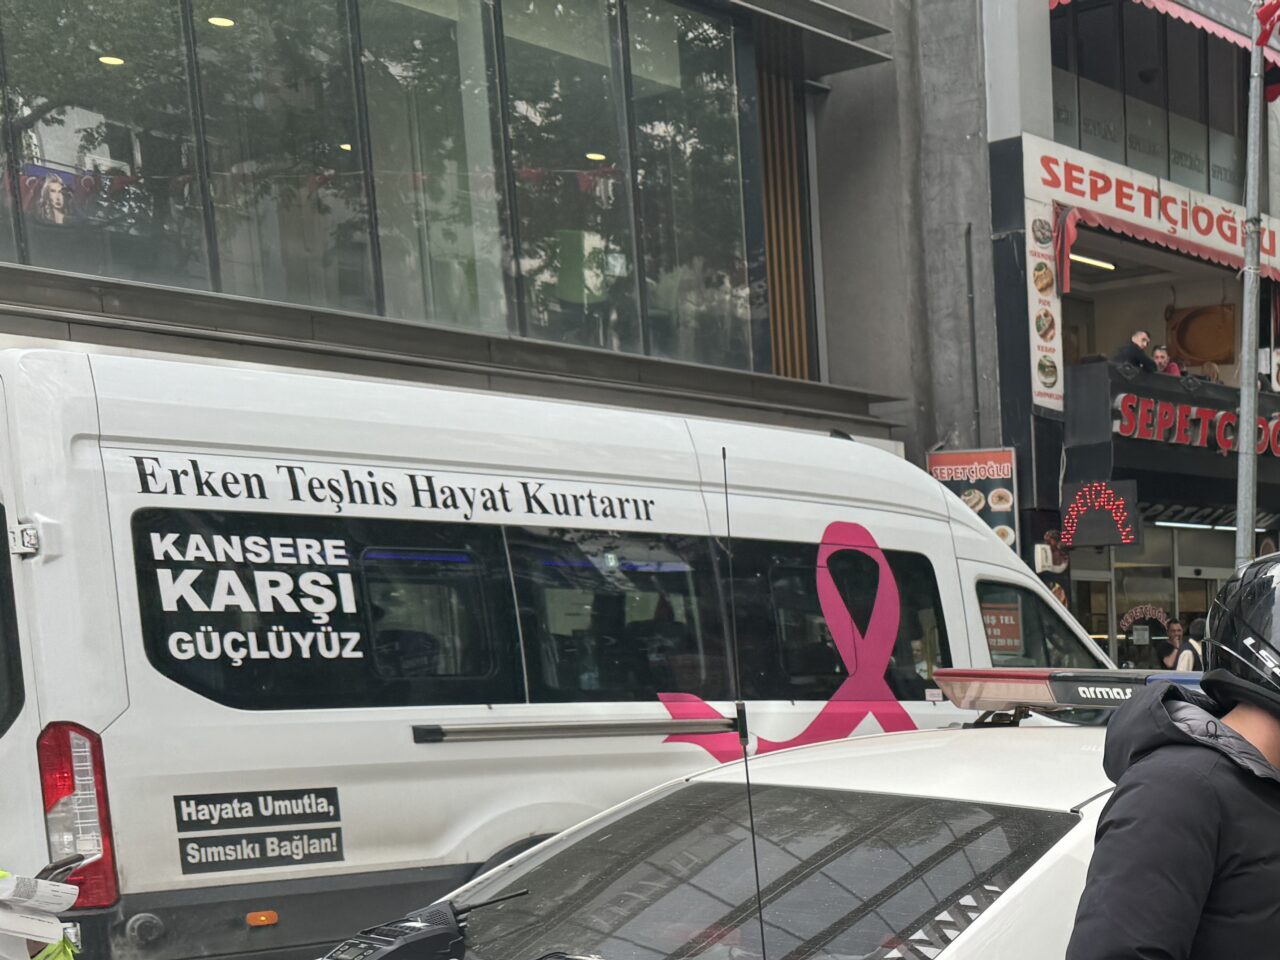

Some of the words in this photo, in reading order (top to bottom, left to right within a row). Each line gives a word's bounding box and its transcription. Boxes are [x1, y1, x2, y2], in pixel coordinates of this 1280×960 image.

[1040, 154, 1277, 257] SEPETÇİOĞU
[130, 455, 267, 500] Erken
[276, 464, 398, 514] Teşhis
[405, 474, 513, 521] Hayat
[518, 482, 656, 521] Kurtarır
[150, 533, 349, 566] KANSERE
[156, 569, 358, 623] KARŞI
[167, 626, 363, 667] GÜÇLÜYÜZ
[1078, 686, 1133, 700] armas
[181, 799, 253, 825] Hayata
[258, 793, 335, 818] Umutla,
[186, 838, 261, 864] Sımsıkı
[265, 832, 338, 861] Bağlan!
